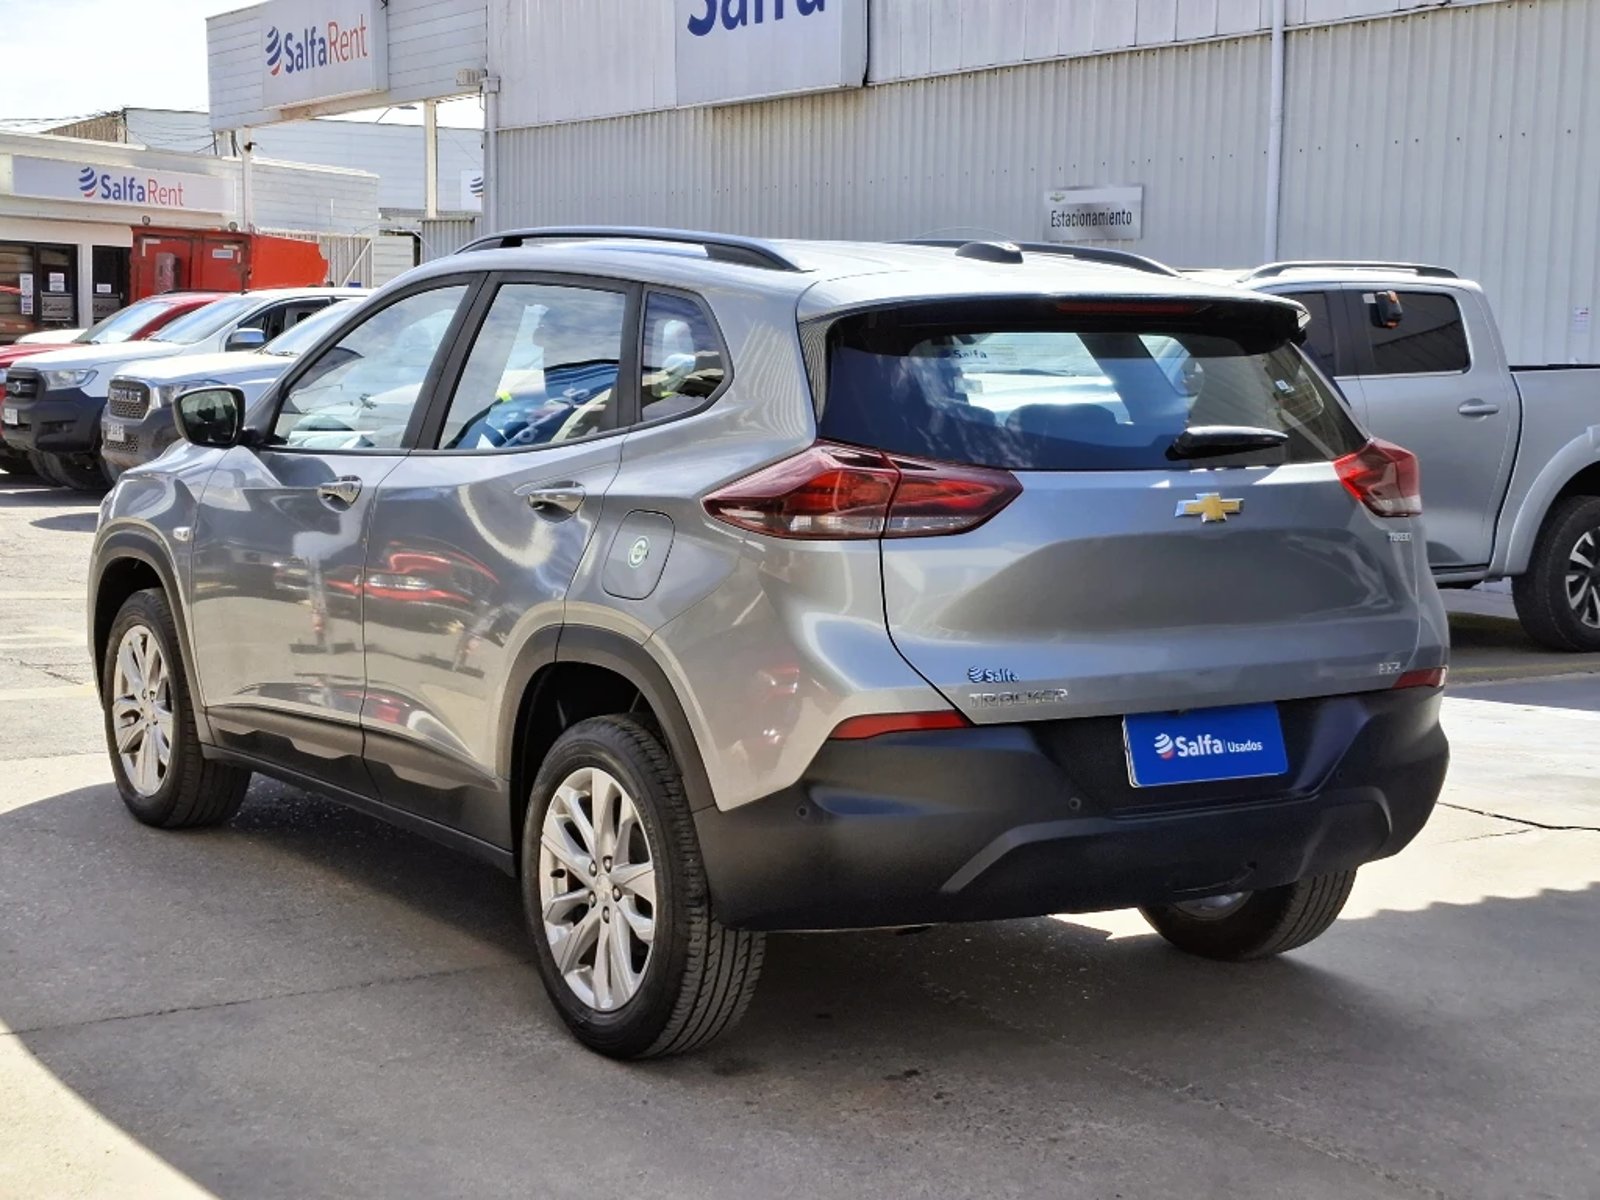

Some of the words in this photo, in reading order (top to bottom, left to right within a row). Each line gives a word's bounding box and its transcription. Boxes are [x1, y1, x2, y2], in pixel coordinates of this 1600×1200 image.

[284, 14, 368, 74] SalfaRent
[100, 174, 184, 207] SalfaRent
[1050, 208, 1132, 227] Estacionamiento
[969, 688, 1069, 707] TRACKER
[1175, 734, 1223, 757] Salfa
[1227, 740, 1263, 753] Usados
